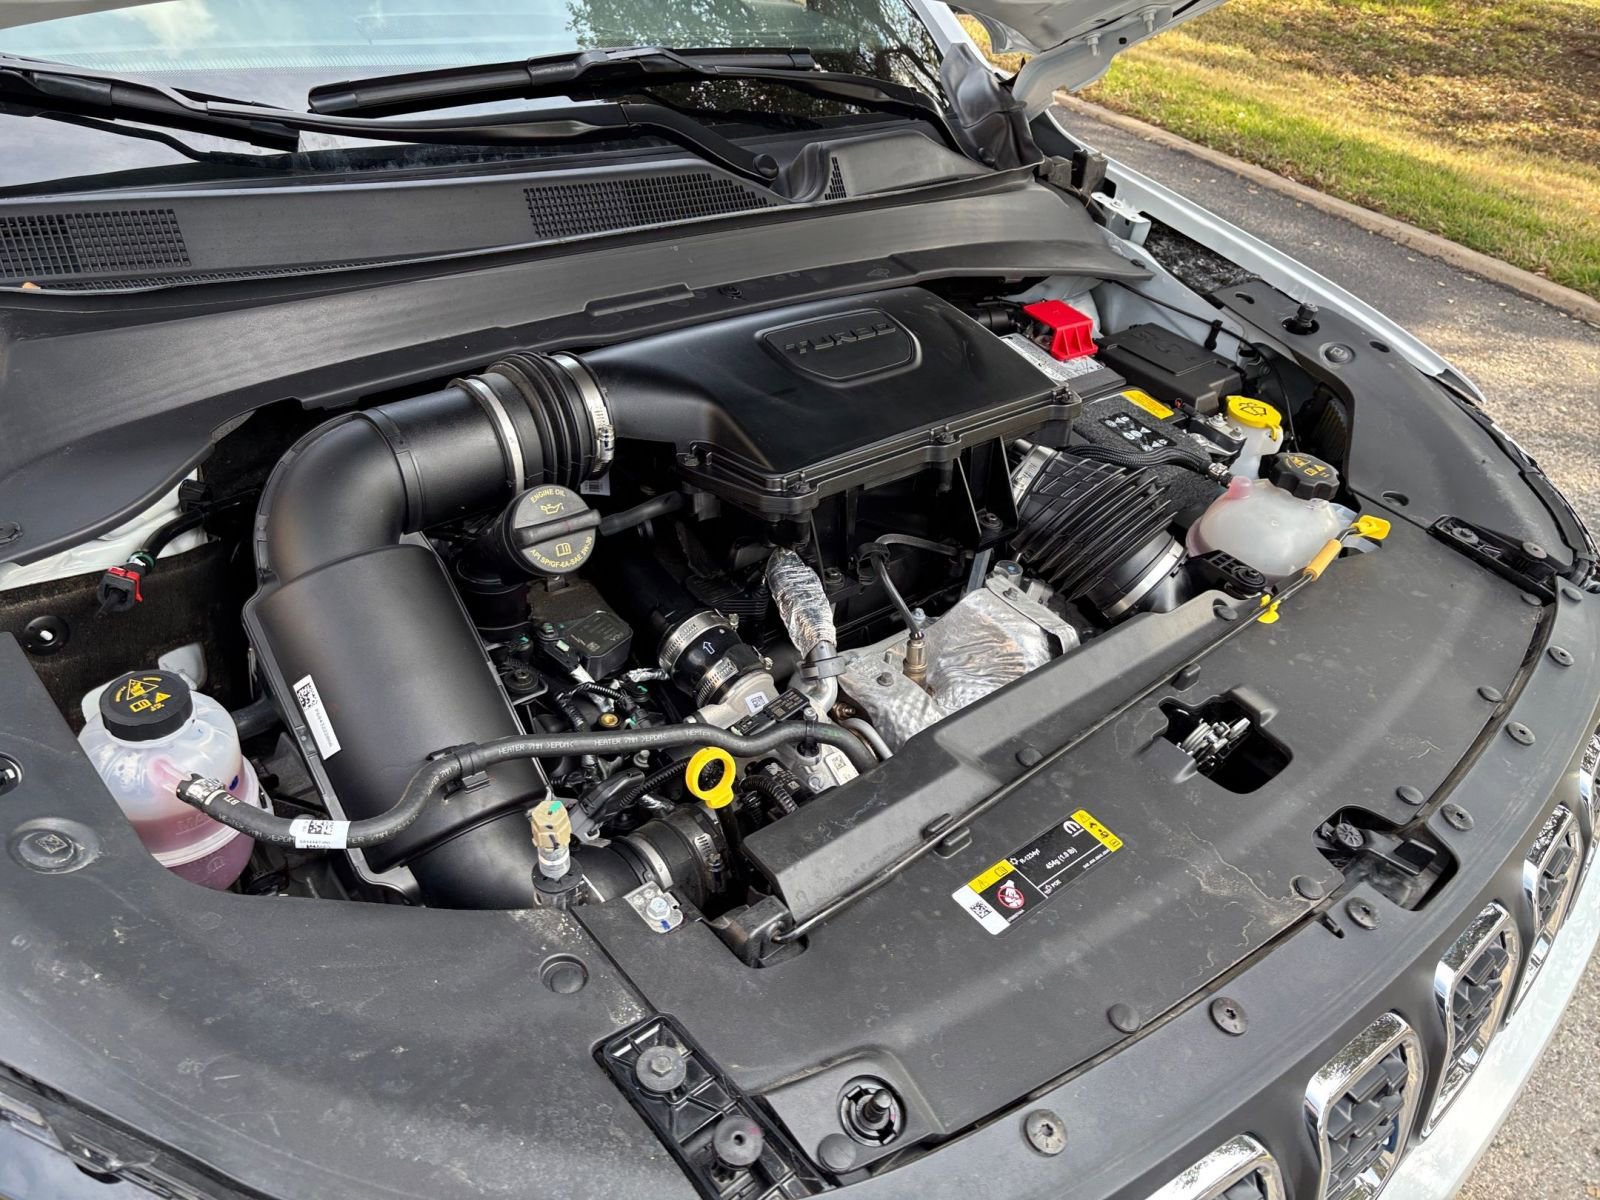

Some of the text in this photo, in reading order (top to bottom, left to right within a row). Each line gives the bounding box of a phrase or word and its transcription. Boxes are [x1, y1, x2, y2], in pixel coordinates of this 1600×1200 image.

[786, 324, 896, 354] TURBO
[530, 488, 566, 503] ENGINE OIL
[529, 548, 542, 561] API
[593, 737, 621, 746] HEATER
[499, 743, 526, 755] HEATER
[1046, 857, 1060, 869] 454g
